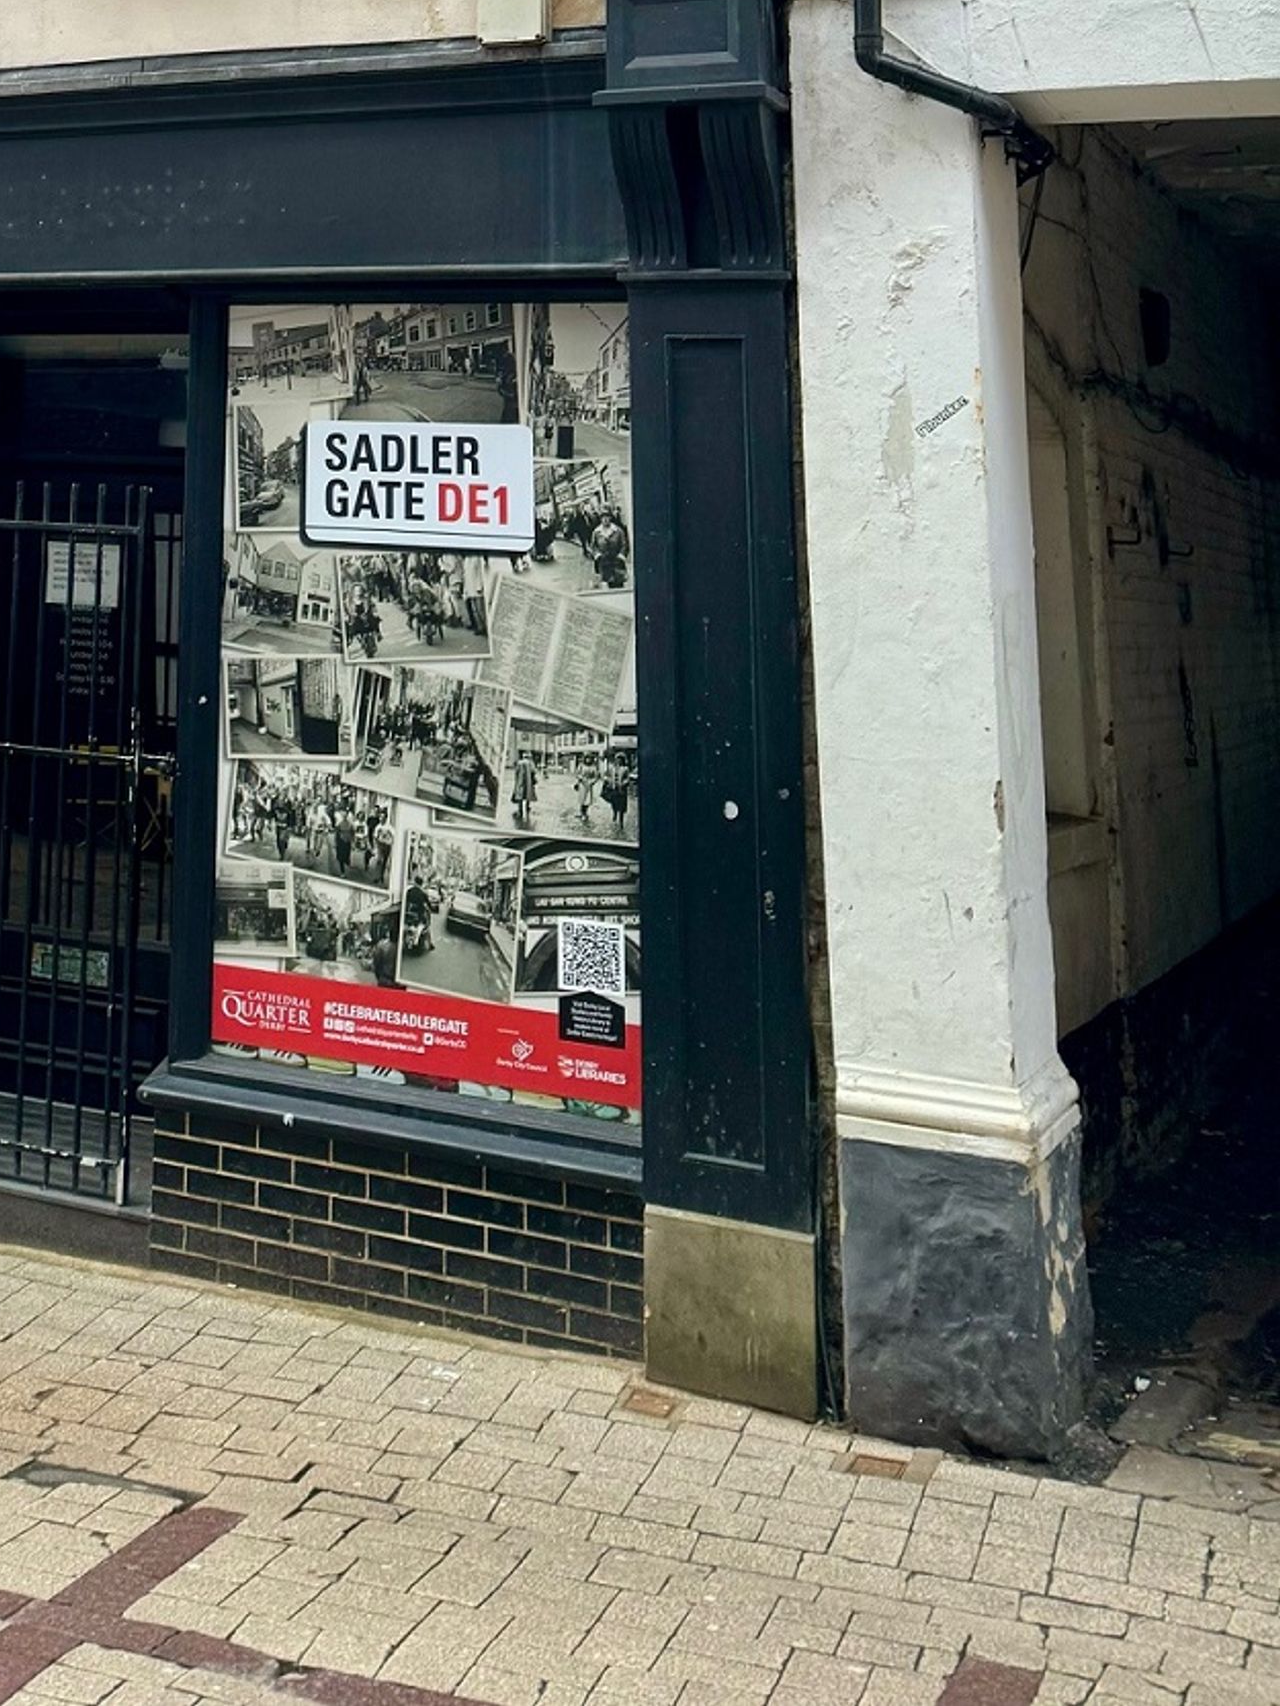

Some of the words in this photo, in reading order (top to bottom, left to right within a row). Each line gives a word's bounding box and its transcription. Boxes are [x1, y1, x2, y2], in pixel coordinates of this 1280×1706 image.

[325, 432, 480, 476] SADLER
[325, 478, 426, 521] GATE
[437, 482, 510, 526] DE1
[221, 994, 312, 1027] QUARTER
[247, 990, 312, 1009] CATHEDRAL
[323, 1001, 468, 1036] #CELEBRATESADLERGATE
